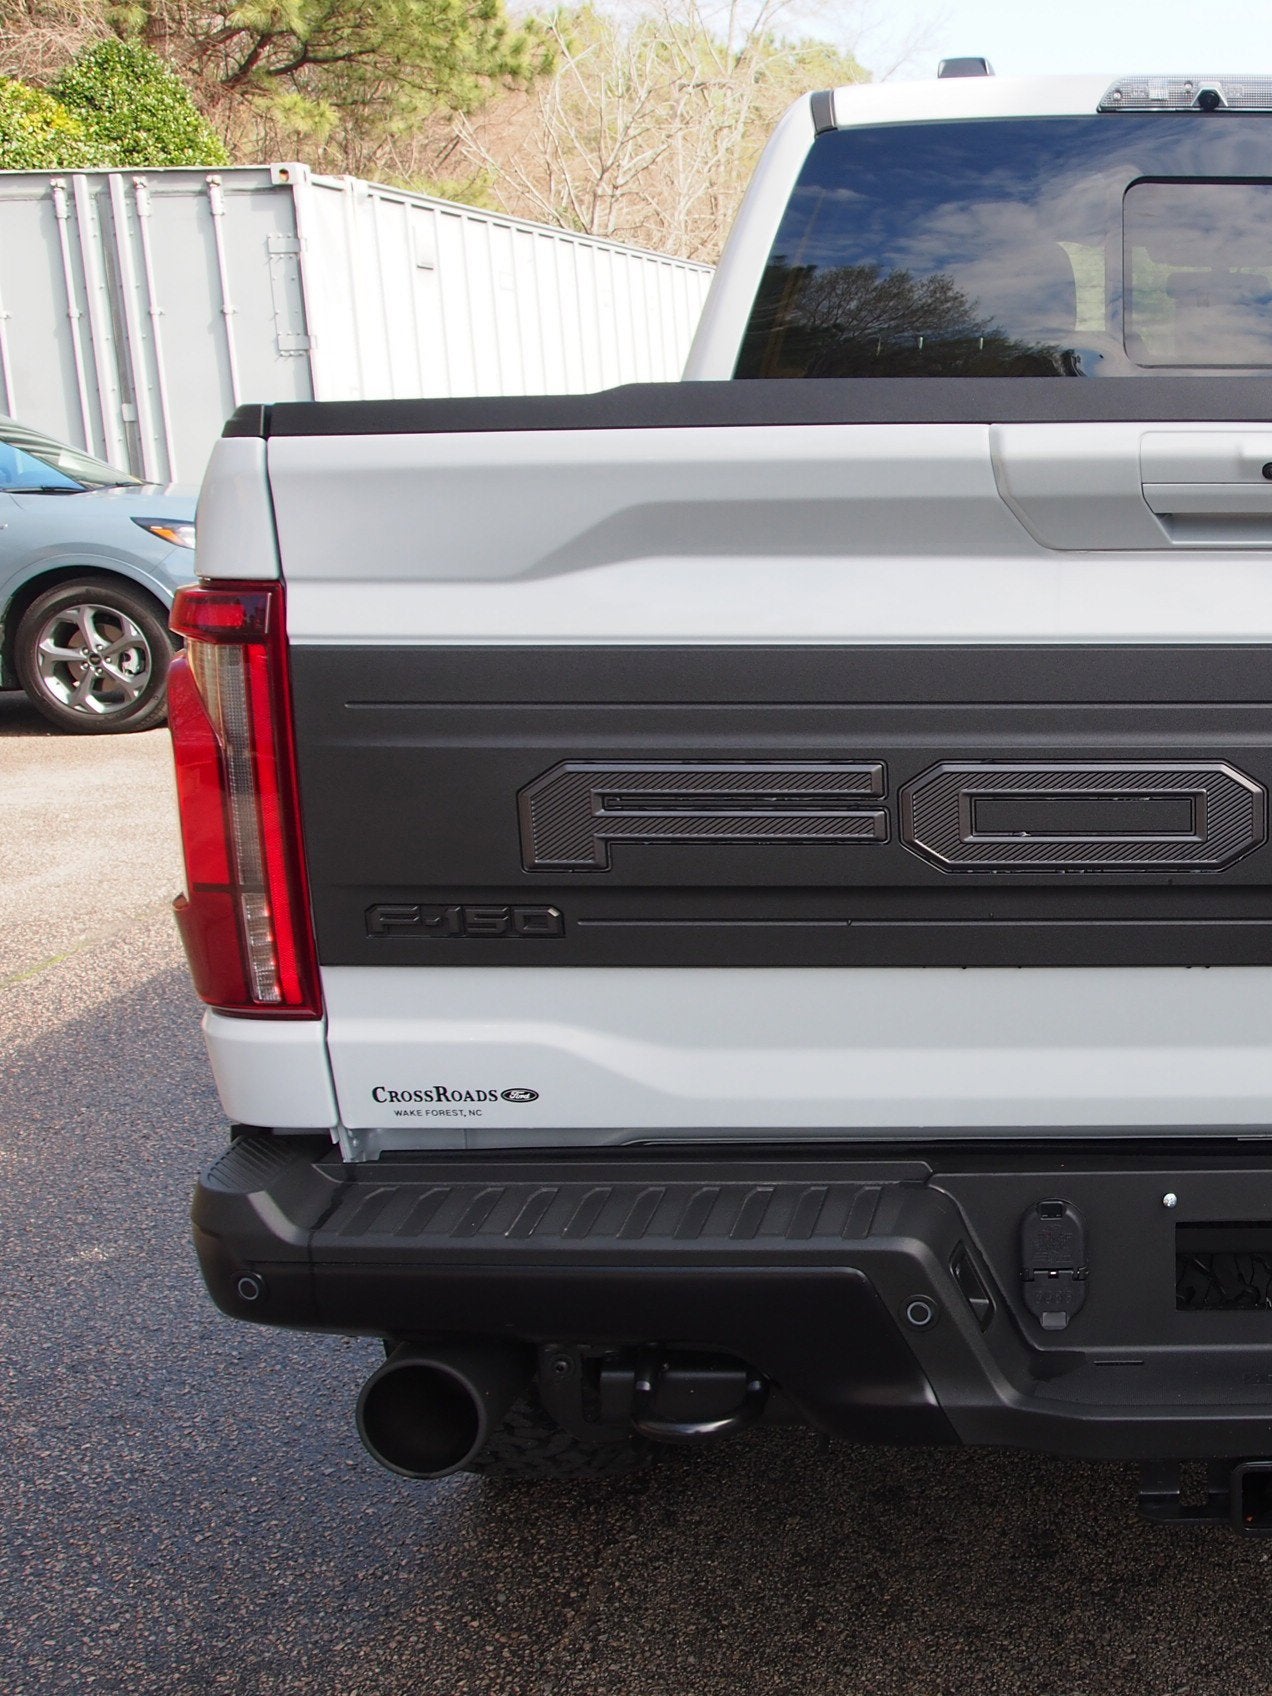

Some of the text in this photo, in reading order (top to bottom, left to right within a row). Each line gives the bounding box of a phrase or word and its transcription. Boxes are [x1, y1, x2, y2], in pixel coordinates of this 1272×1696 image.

[364, 903, 565, 938] F-150
[394, 1109, 482, 1118] WAKE FOREST, NC
